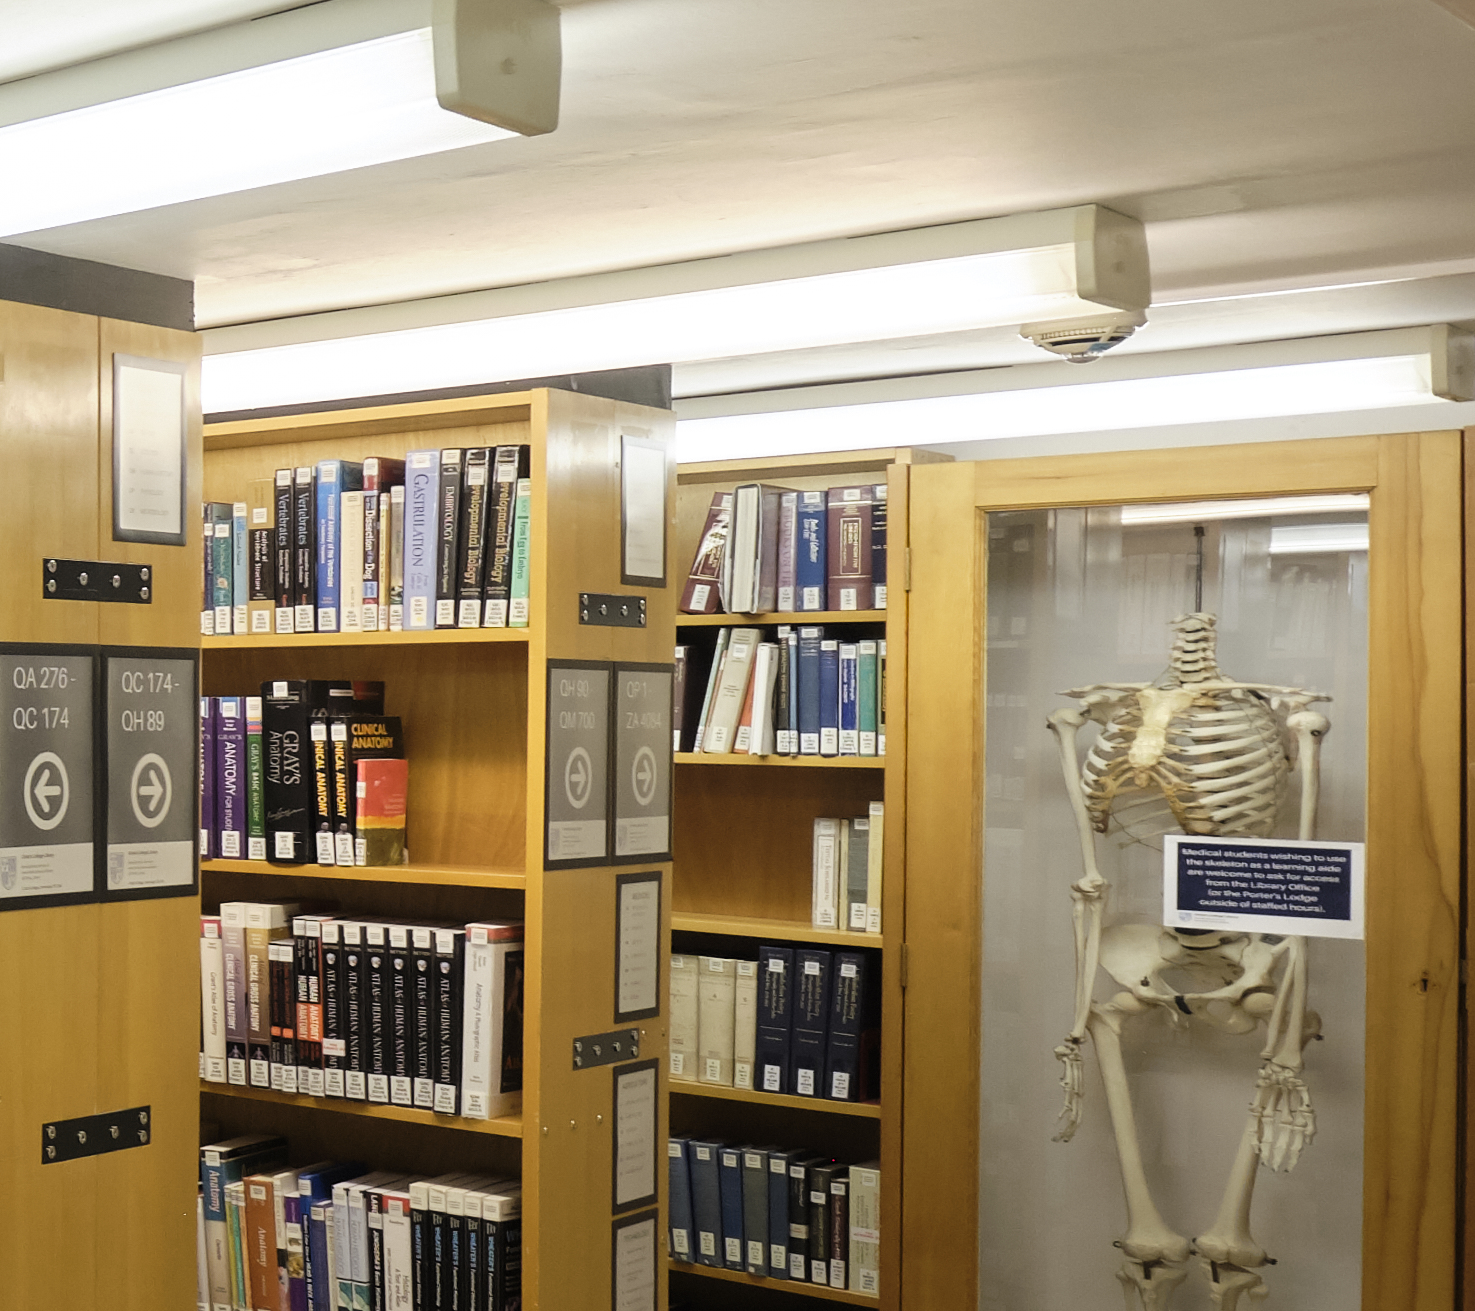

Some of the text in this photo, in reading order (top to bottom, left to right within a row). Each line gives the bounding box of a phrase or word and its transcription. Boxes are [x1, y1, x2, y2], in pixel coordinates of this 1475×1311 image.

[278, 493, 290, 547] Vertebrates
[298, 492, 310, 546] Vertebrates
[413, 474, 430, 567] GASTRULATION
[443, 486, 455, 542] EMBRYOLOGY
[13, 667, 37, 689] QA
[40, 667, 68, 688] 276
[122, 671, 143, 693] QC
[13, 707, 69, 729] QC 174
[122, 710, 164, 731] QH 89
[351, 723, 388, 735] CLINICAL
[267, 731, 282, 784] Anatomy
[283, 731, 301, 785] GRAY'S
[352, 737, 393, 749] ANATOMY
[225, 742, 236, 796] ANATOMY
[1250, 881, 1286, 891] Library
[1288, 883, 1320, 892] Office
[308, 975, 320, 1040] HUMAN ANATOMY
[208, 1170, 220, 1213] Anatomy
[257, 1226, 267, 1268] Anatomy
